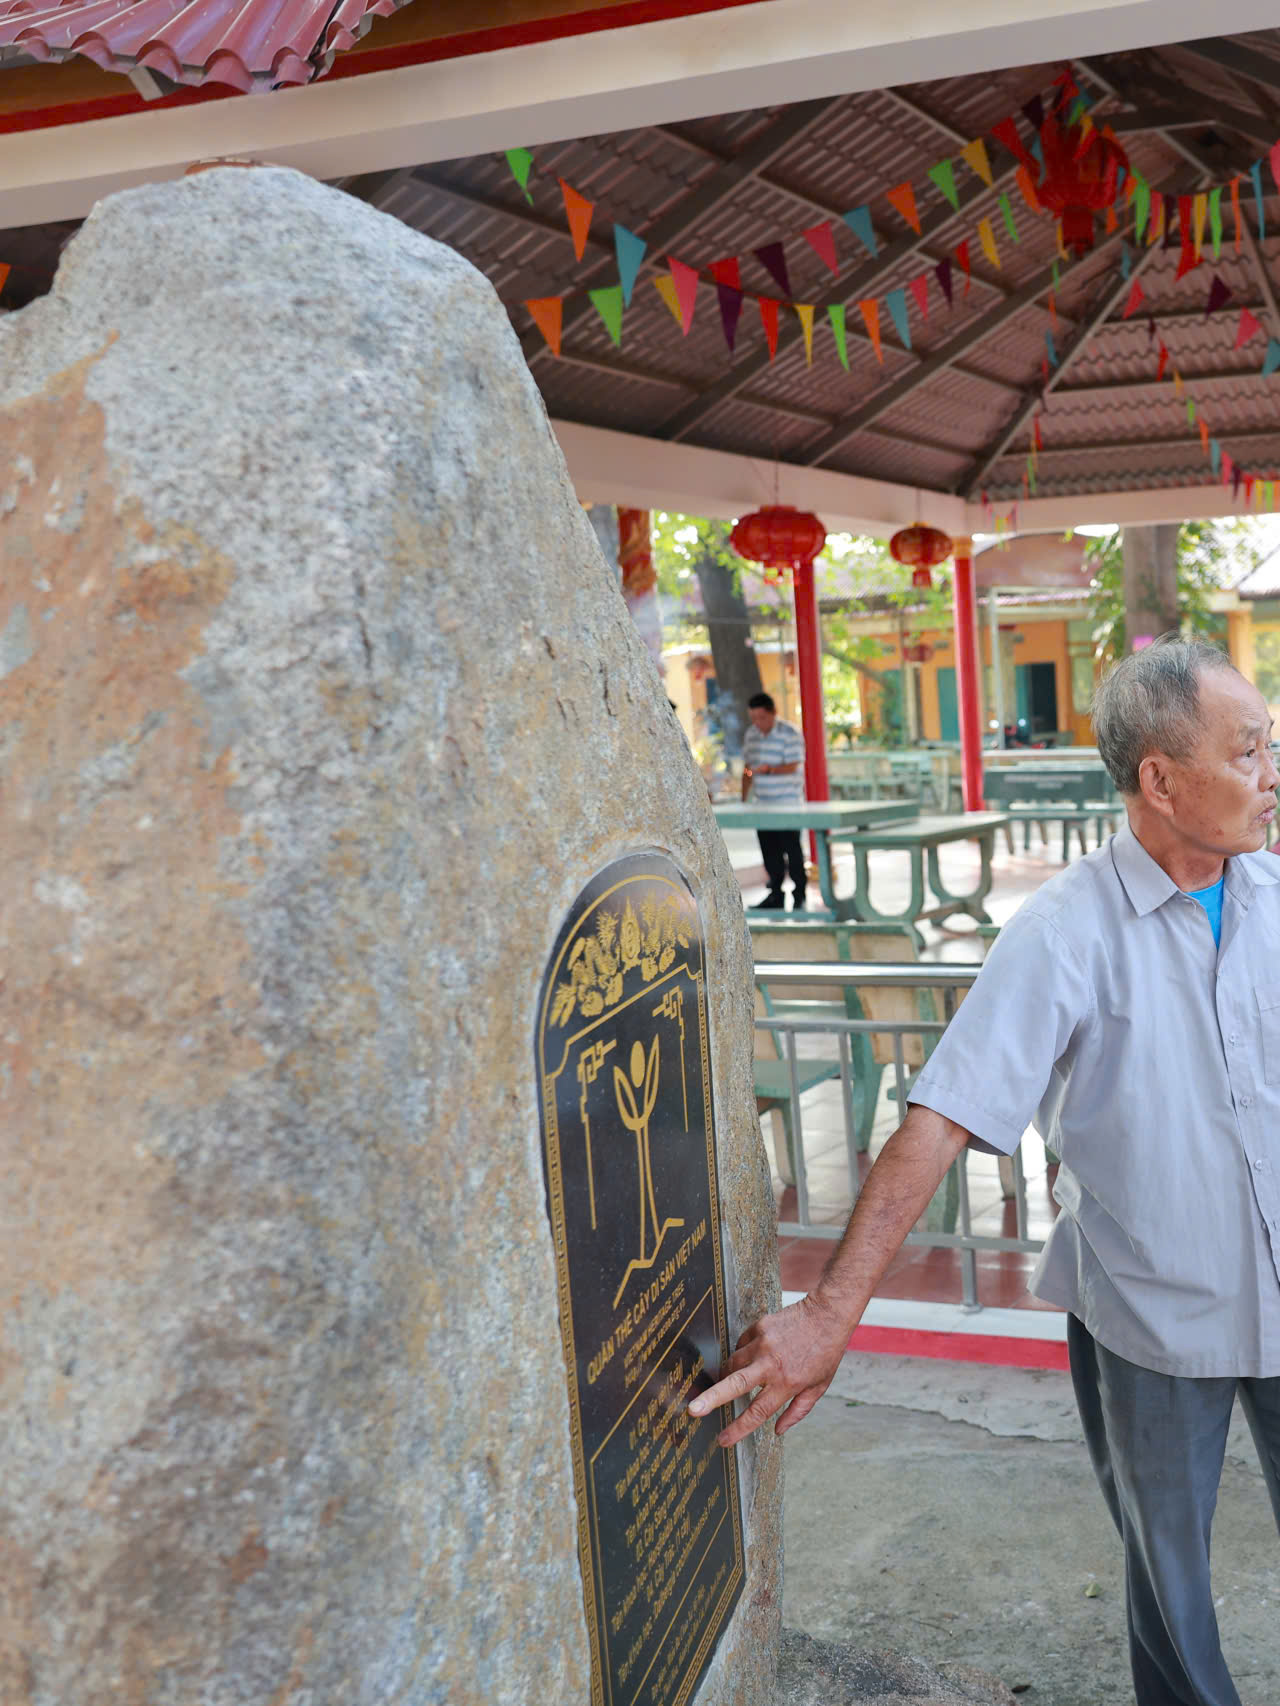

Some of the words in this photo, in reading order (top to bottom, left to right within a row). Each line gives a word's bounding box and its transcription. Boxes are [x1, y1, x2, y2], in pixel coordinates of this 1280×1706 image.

[633, 1292, 650, 1324] CÂY
[651, 1278, 660, 1303] DI
[660, 1257, 676, 1290] SẢN
[675, 1237, 691, 1269] VIỆT
[691, 1217, 706, 1250] NAM
[648, 1296, 672, 1335] HERITAGE
[672, 1279, 685, 1302] TREE
